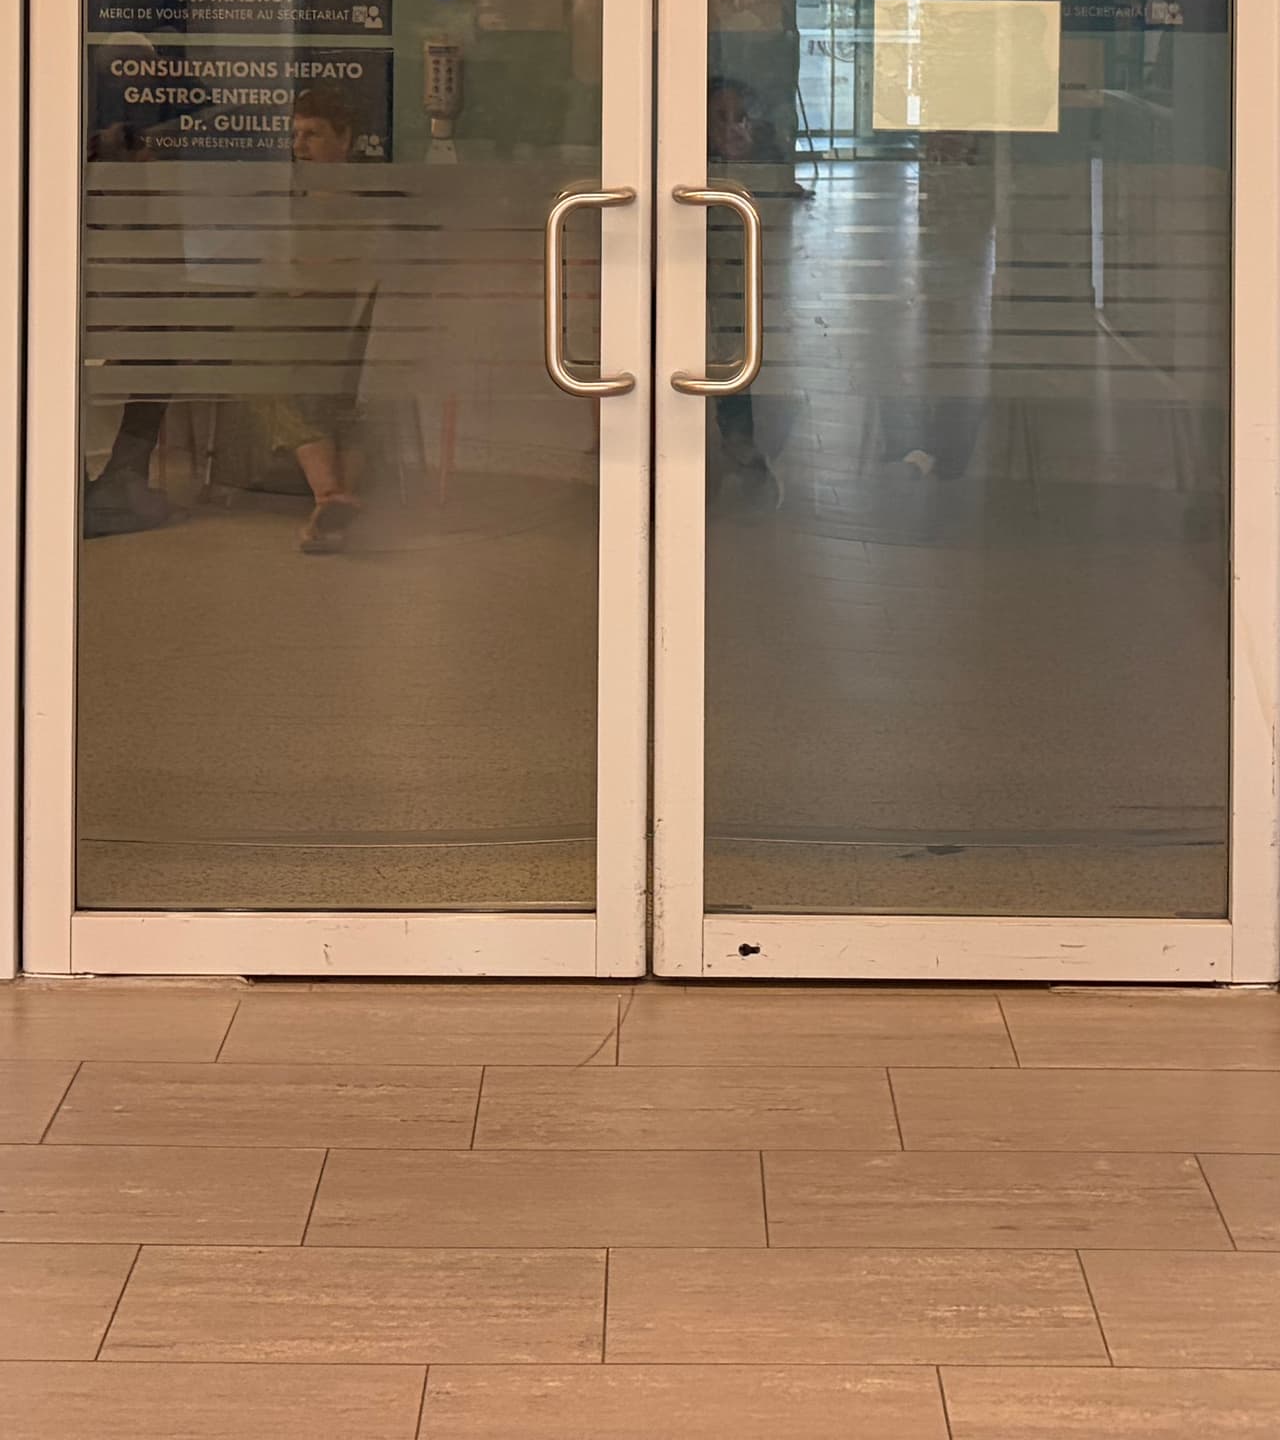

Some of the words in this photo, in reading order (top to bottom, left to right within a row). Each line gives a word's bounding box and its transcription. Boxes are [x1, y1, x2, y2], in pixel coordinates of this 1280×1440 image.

[99, 7, 134, 19] MERCI
[137, 7, 153, 19] DE
[156, 7, 189, 19] VOUS
[257, 8, 273, 20] AU
[110, 59, 277, 78] CONSULTATIONS
[284, 61, 364, 79] HEPATO
[124, 86, 310, 106] GASTRO-ENTERO
[179, 114, 207, 132] Dr.
[214, 114, 292, 133] GUILLET
[156, 136, 189, 148] VOUS
[256, 137, 274, 149] AU
